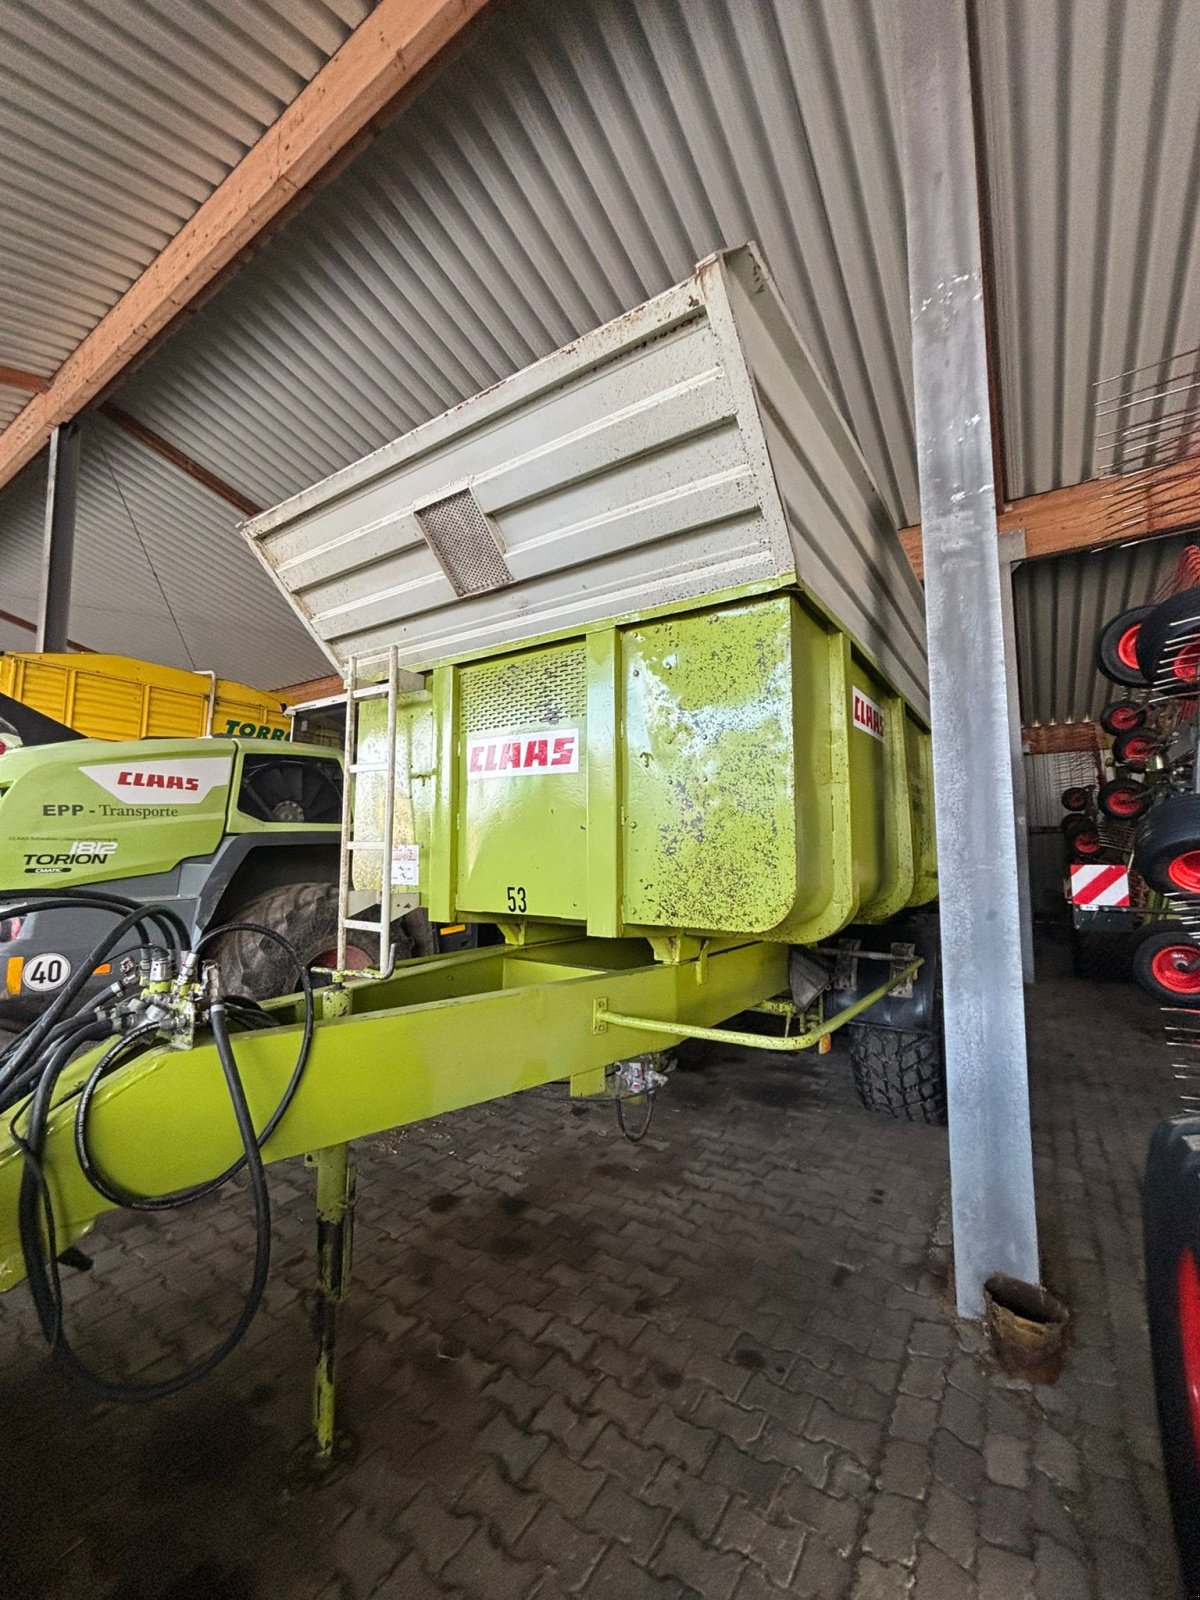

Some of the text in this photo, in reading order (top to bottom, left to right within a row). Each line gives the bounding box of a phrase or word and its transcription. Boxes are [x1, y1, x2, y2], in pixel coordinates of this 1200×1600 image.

[469, 736, 575, 773] CLAAS
[117, 771, 199, 791] CLAAS
[42, 805, 84, 817] EPP
[98, 804, 179, 820] Transporte
[69, 841, 118, 855] 1812
[23, 853, 108, 866] TORION
[507, 886, 527, 913] 53
[30, 959, 62, 984] 40
